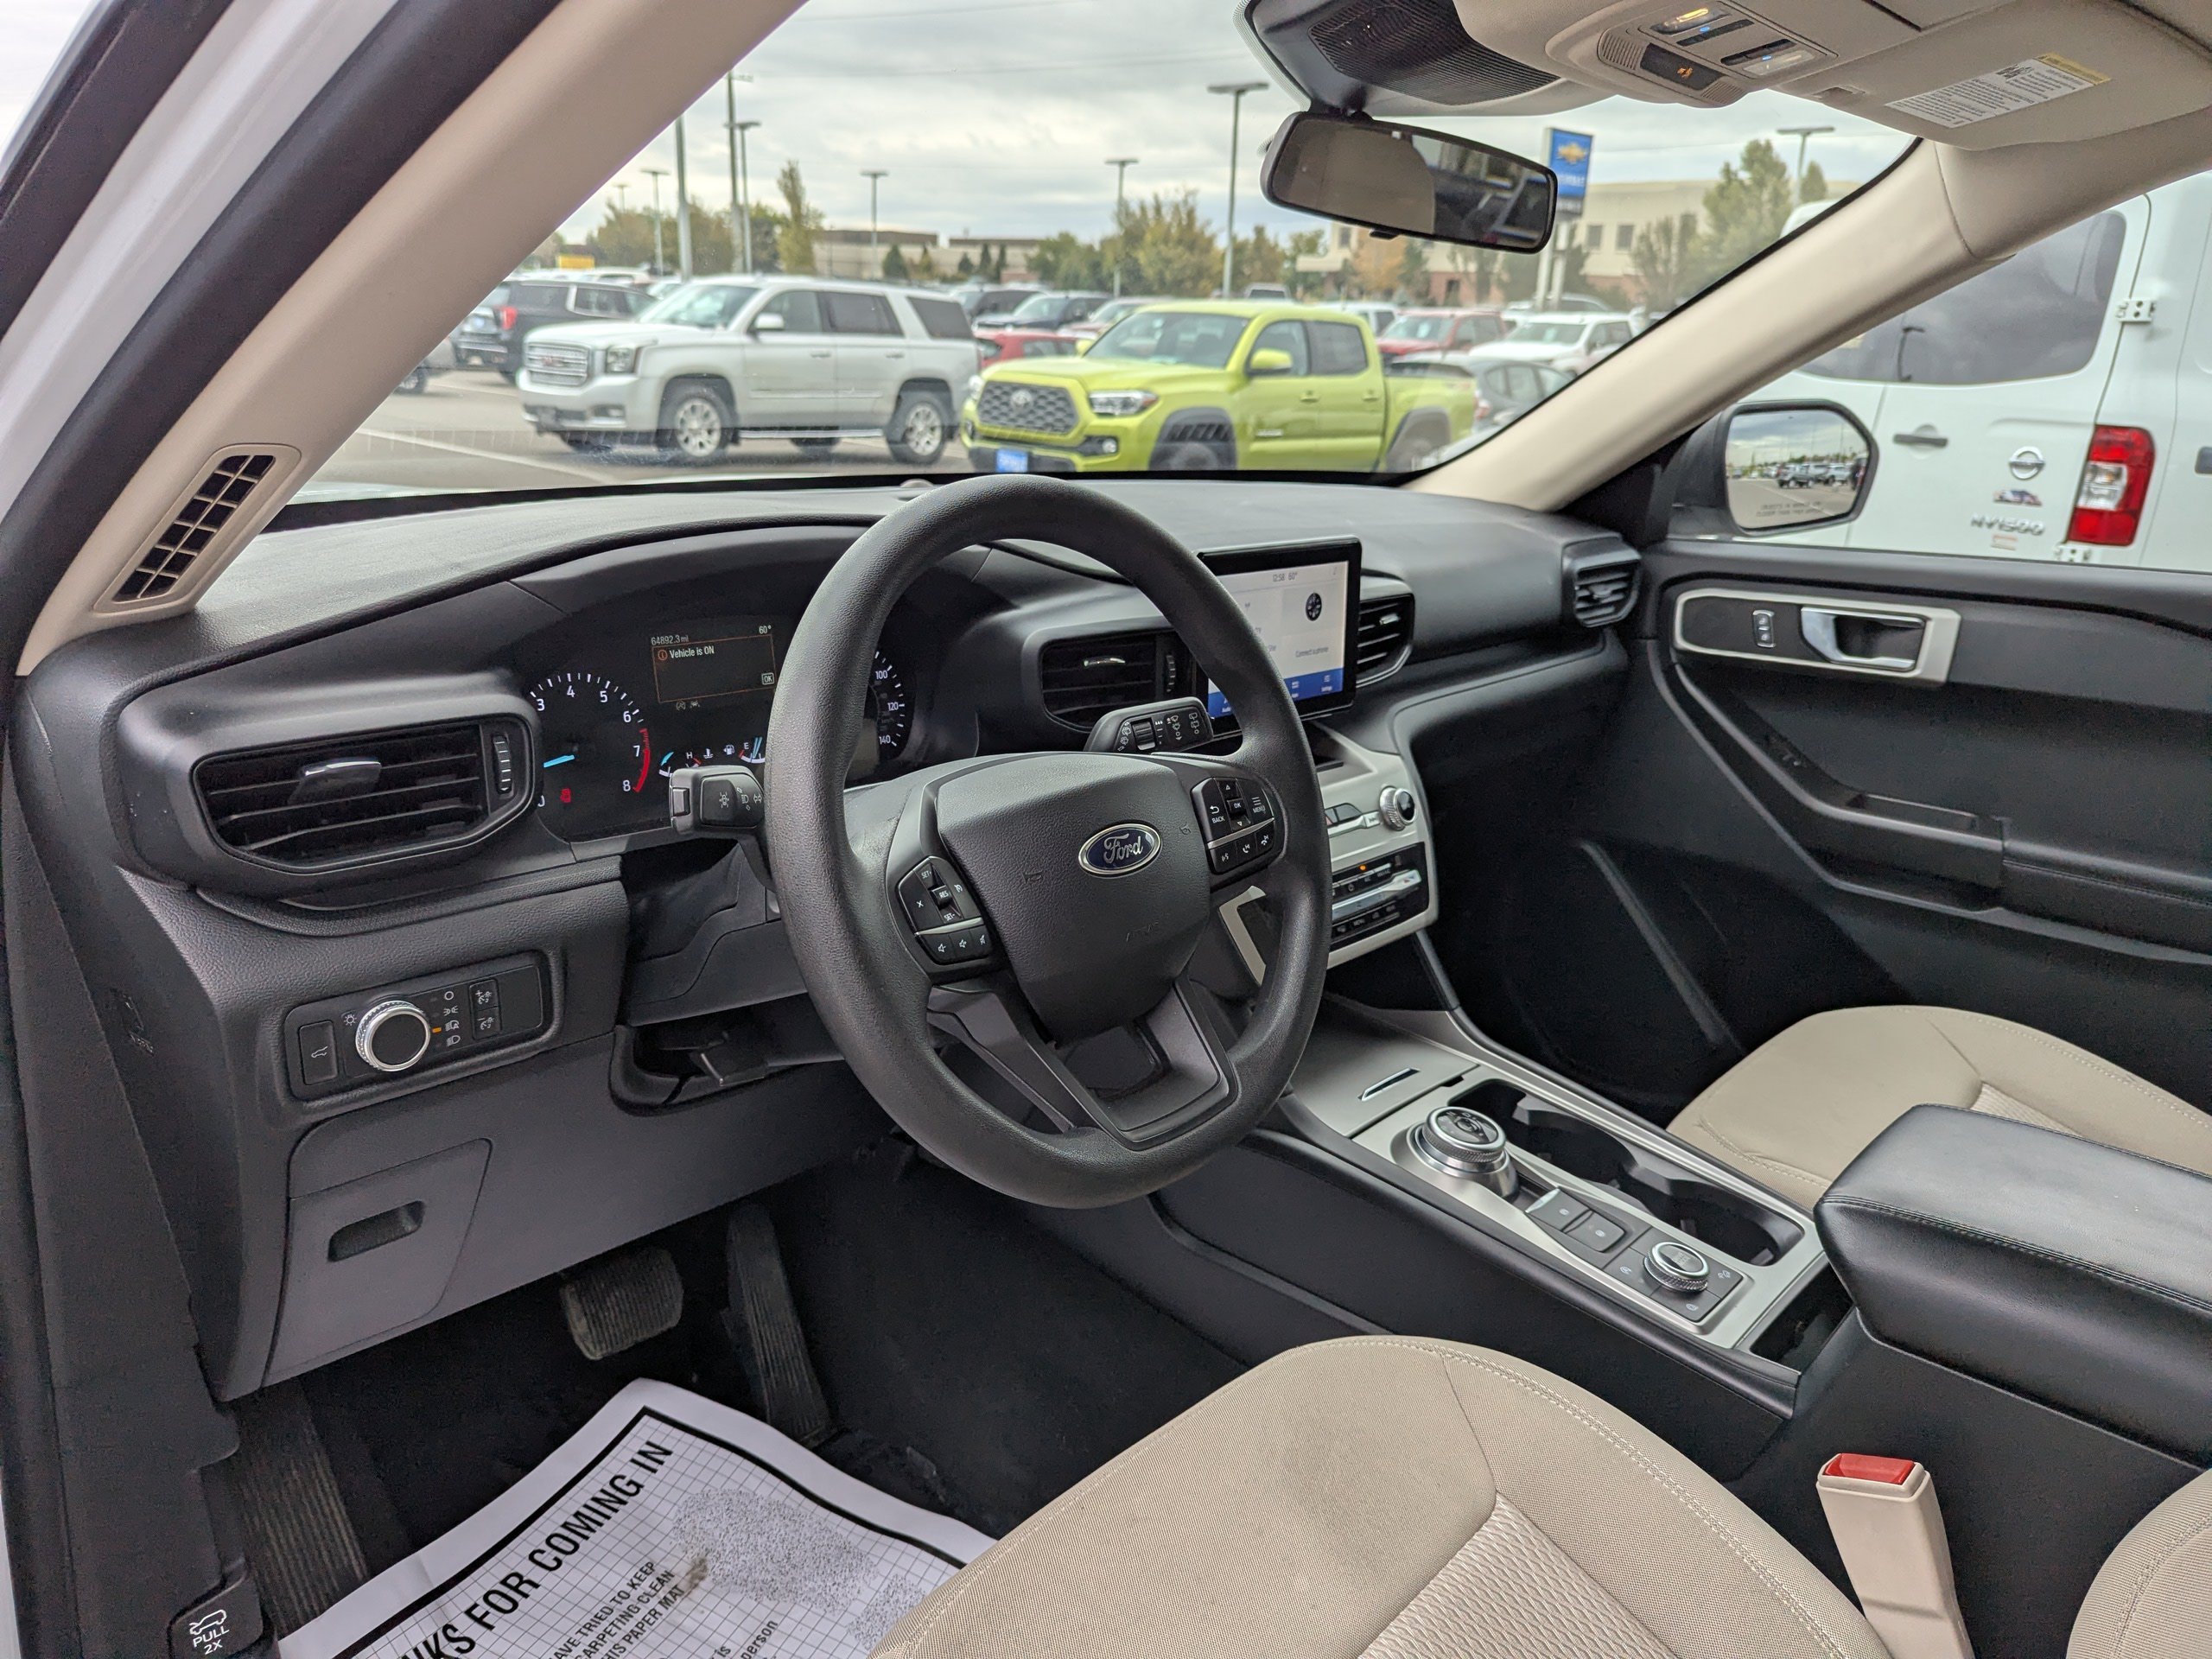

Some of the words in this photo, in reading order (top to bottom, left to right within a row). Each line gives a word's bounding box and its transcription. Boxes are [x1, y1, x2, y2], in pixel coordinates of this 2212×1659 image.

[651, 634, 681, 646] 64892.3
[669, 648, 696, 659] Vehicle
[696, 647, 703, 656] is
[704, 645, 715, 655] ON
[875, 670, 888, 680] 100
[566, 685, 575, 697] 4
[600, 690, 608, 702] 5
[536, 698, 545, 711] 3
[887, 702, 899, 711] 120
[623, 710, 632, 722] 6
[879, 734, 891, 745] 140
[632, 745, 641, 757] 7
[622, 779, 631, 791] 8
[1103, 834, 1144, 864] Ford
[938, 890, 949, 899] RES
[464, 1571, 542, 1631] FOR
[528, 1473, 645, 1572] COMING
[629, 1440, 673, 1474] IN
[637, 1569, 675, 1605] CLEAN
[550, 1637, 581, 1659] AVE
[575, 1605, 614, 1637] TRIED
[610, 1590, 631, 1606] TO
[626, 1561, 657, 1591] KEEP
[622, 1608, 664, 1645] PAPER
[658, 1583, 685, 1611] MAT
[193, 1625, 230, 1648] PULL
[741, 1620, 779, 1659] person
[204, 1639, 223, 1656] 2X
